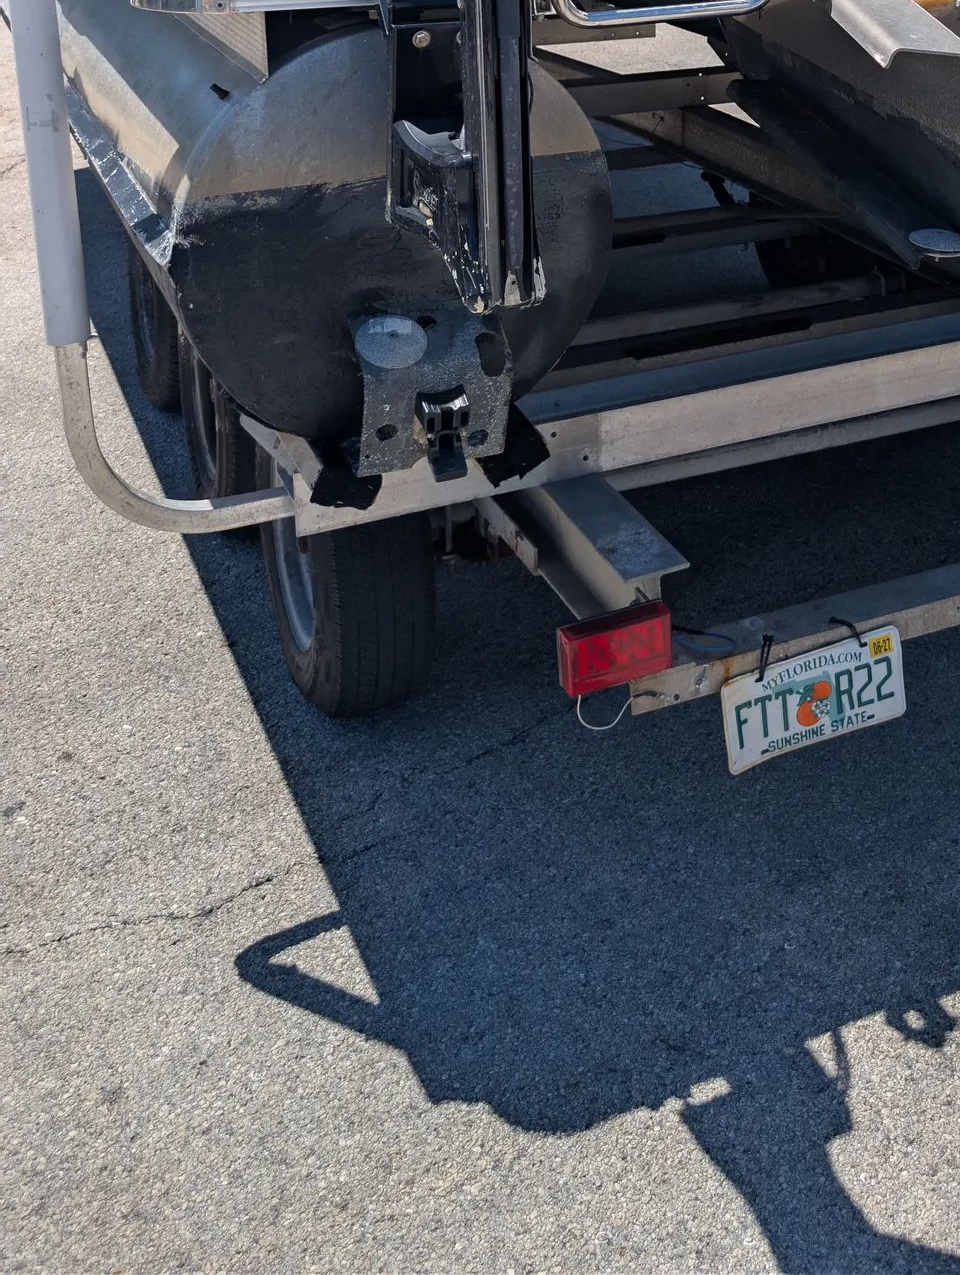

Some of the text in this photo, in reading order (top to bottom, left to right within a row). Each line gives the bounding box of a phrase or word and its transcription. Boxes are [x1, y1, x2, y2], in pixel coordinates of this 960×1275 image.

[872, 637, 892, 655] 06-27
[761, 652, 863, 692] MYFLORIDA.COM
[734, 655, 895, 750] FTT R22
[768, 710, 868, 753] SUNSHINE STATE
